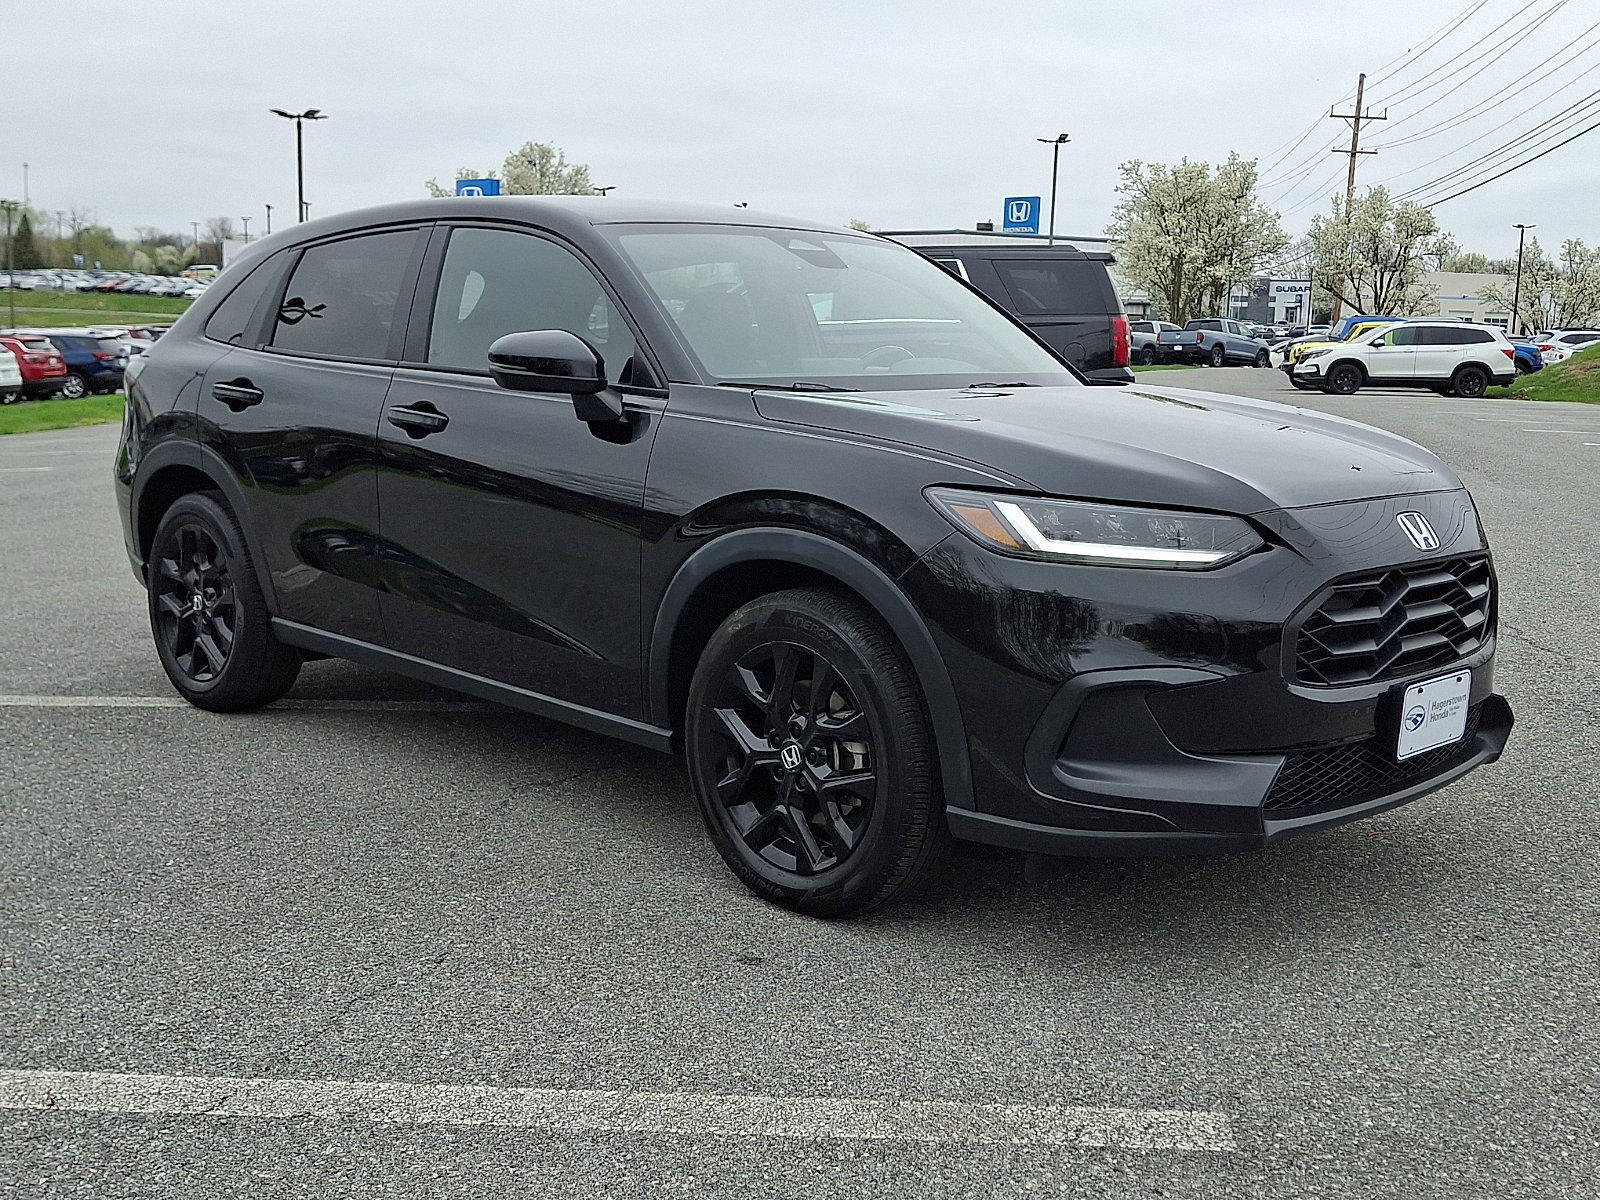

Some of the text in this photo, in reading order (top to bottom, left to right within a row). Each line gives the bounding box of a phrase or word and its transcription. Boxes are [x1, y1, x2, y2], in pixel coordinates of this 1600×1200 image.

[1275, 285, 1311, 293] SUBAR
[784, 613, 834, 641] KINERGY
[1432, 694, 1467, 711] Hagerstown
[1430, 709, 1449, 723] Honda
